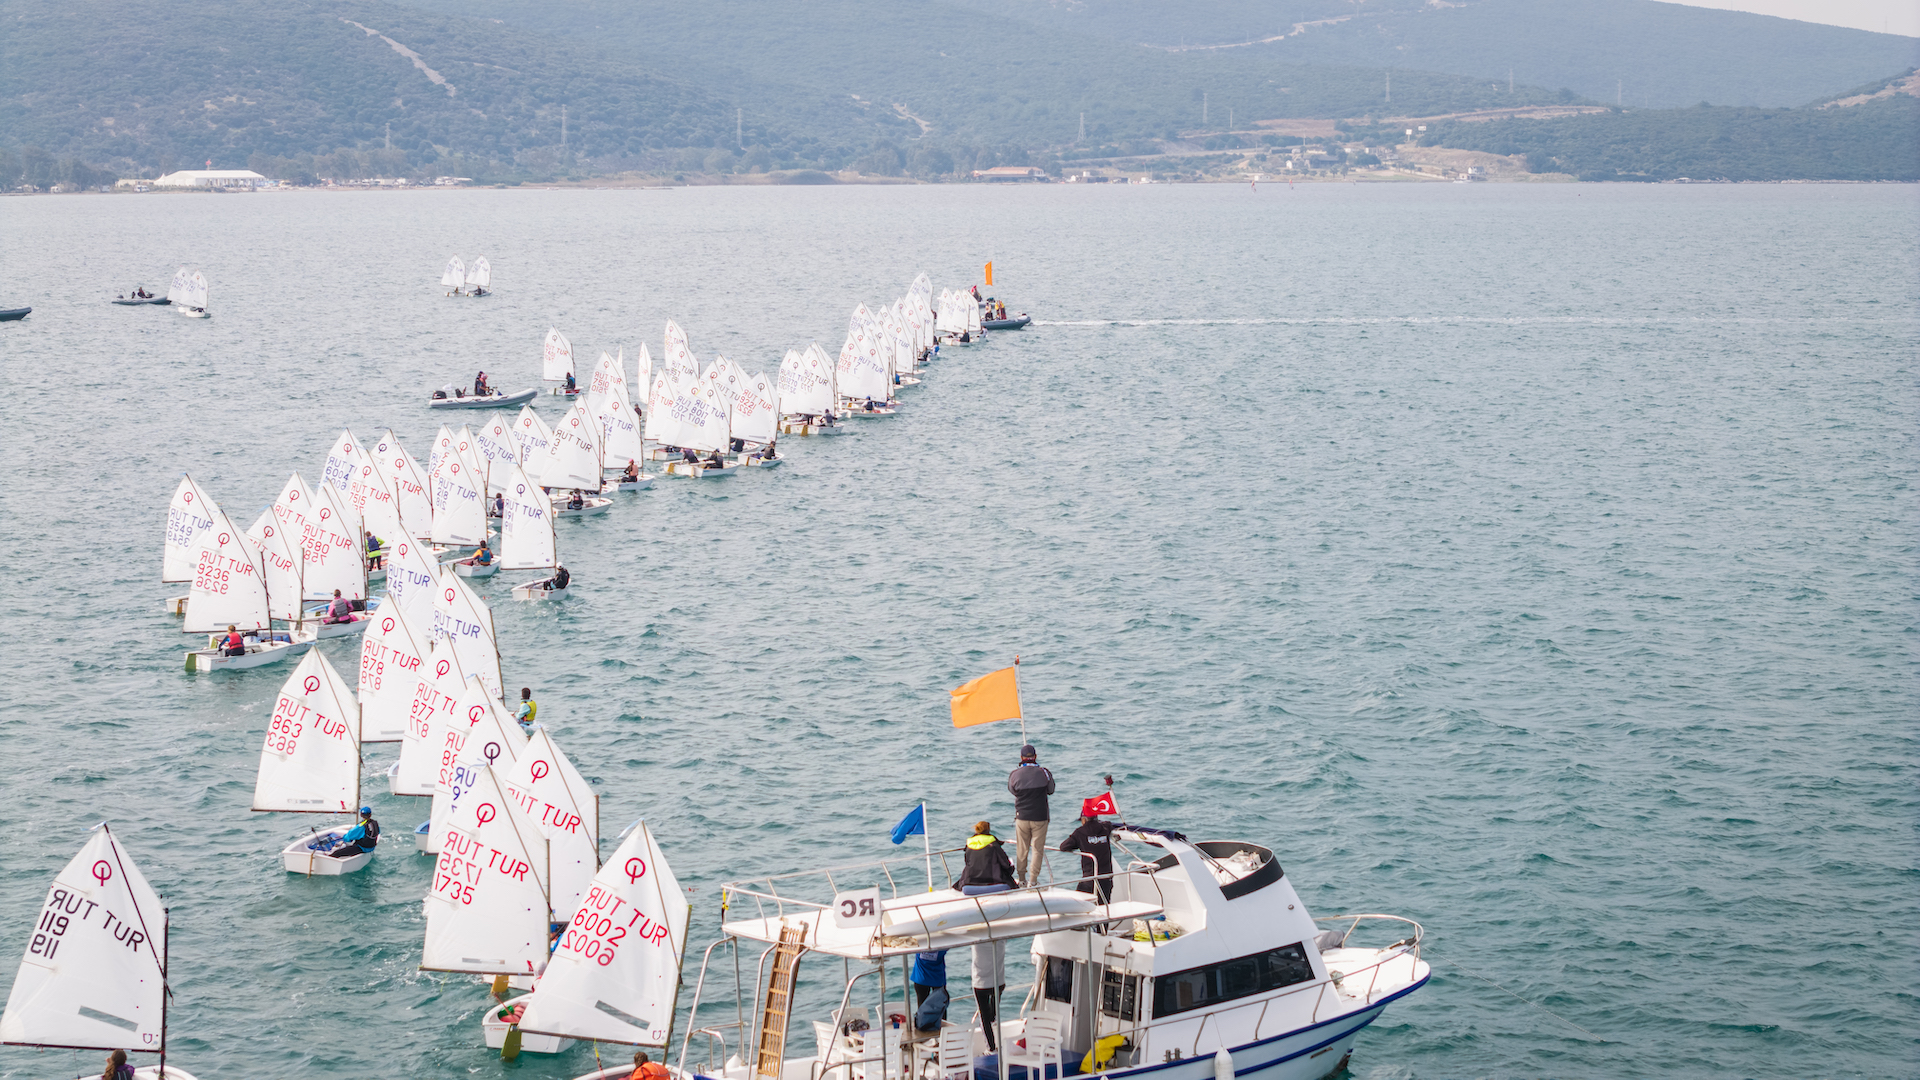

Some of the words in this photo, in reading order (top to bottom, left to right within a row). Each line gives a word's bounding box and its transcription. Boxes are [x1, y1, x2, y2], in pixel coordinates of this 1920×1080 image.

[617, 420, 634, 432] TUR
[530, 437, 548, 449] TUR
[576, 437, 592, 452] TUR
[497, 446, 514, 462] TUR
[370, 487, 390, 503] TUR
[402, 480, 422, 496] TUR
[457, 486, 476, 501] TUR
[523, 505, 542, 520] TUR
[168, 520, 192, 536] 3549
[192, 516, 213, 532] TUR
[300, 535, 330, 554] 7580
[329, 532, 352, 550] TUR
[228, 558, 253, 576] TUR
[270, 552, 292, 572] TUR
[197, 563, 230, 582] 9236
[408, 570, 430, 588] TUR
[388, 577, 404, 593] 745
[434, 624, 458, 644] 935
[455, 619, 480, 639] TUR
[362, 656, 384, 675] 878
[392, 650, 420, 672] TUR
[412, 700, 434, 720] 877
[272, 714, 303, 738] 863
[314, 713, 346, 740] TUR
[544, 803, 581, 834] TUR
[488, 849, 529, 882] TUR
[434, 872, 475, 904] 1735
[39, 911, 70, 936] 119
[103, 910, 145, 952] TUR
[574, 908, 626, 947] 6002
[628, 908, 668, 947] TUR
